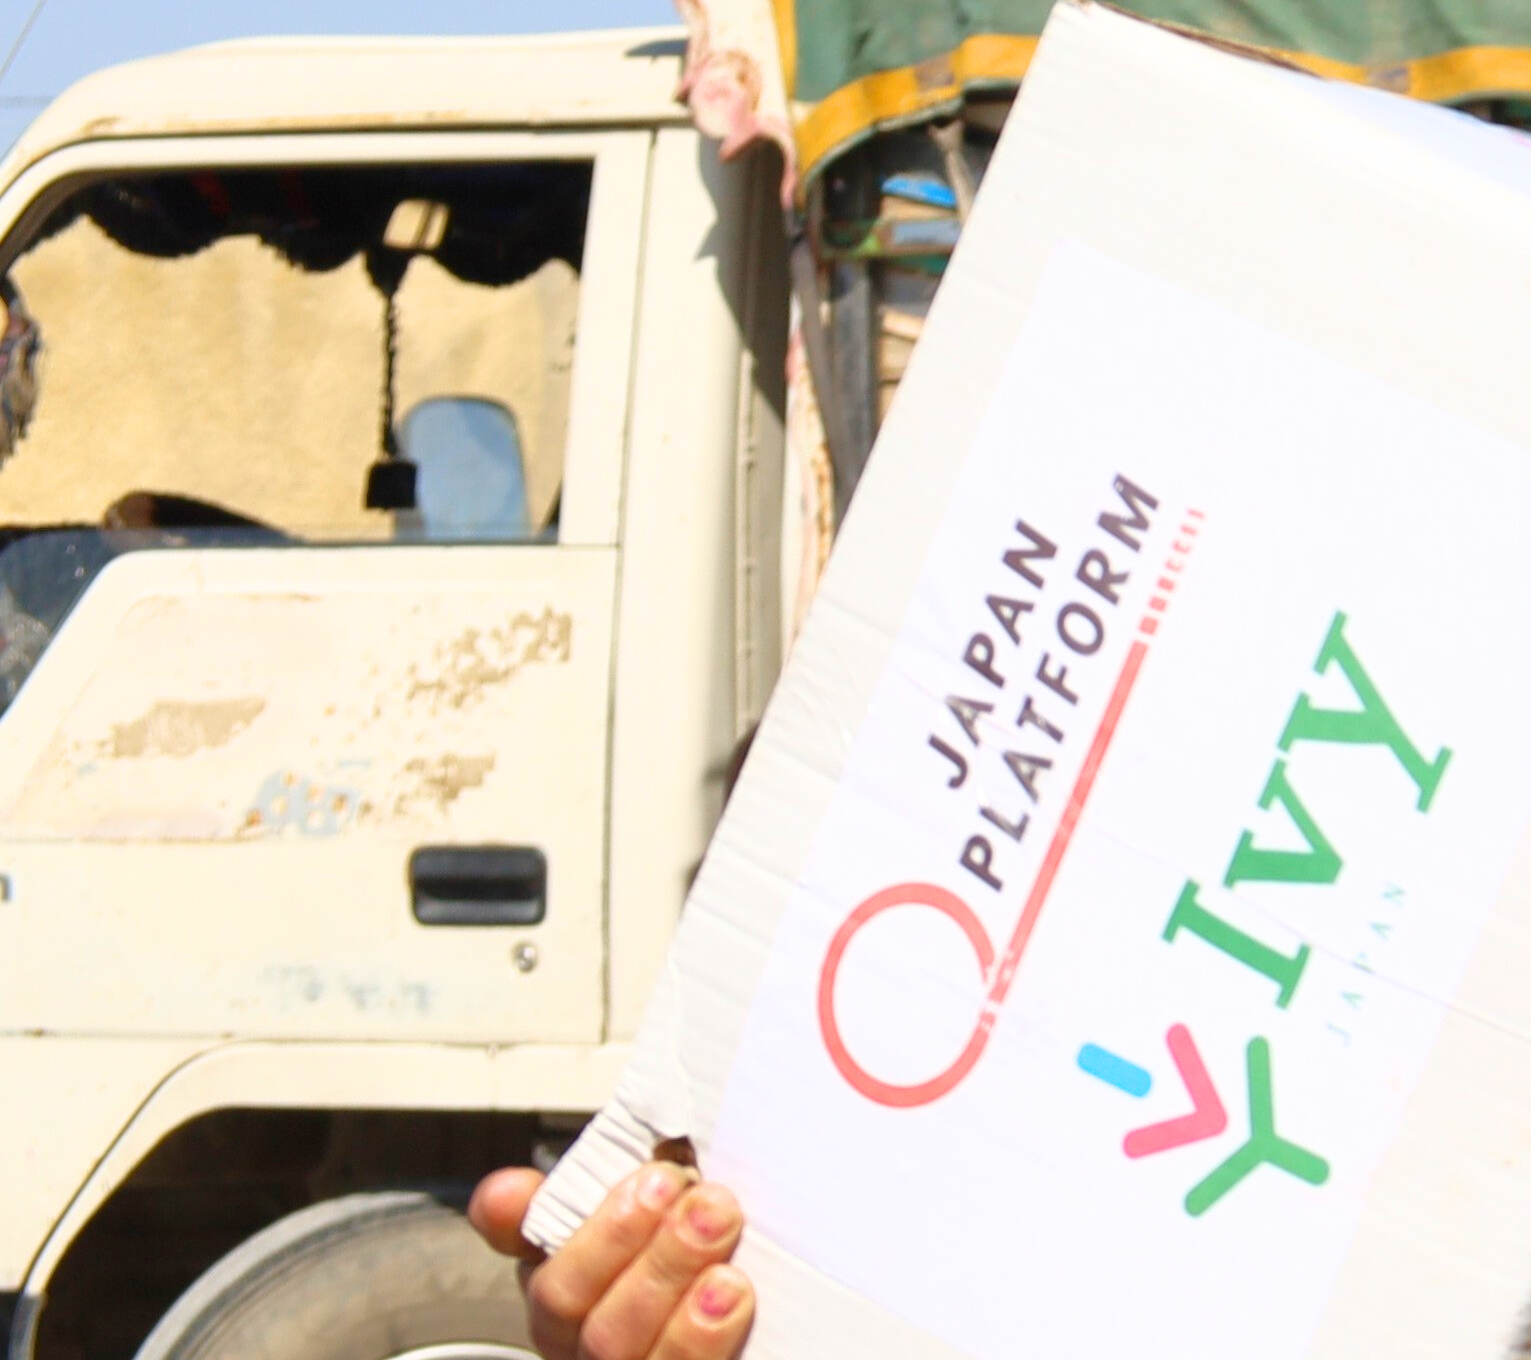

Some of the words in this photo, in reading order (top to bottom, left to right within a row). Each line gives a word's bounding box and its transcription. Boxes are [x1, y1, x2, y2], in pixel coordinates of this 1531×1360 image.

[927, 519, 1059, 790] JAPAN
[959, 473, 1160, 893] PLATFORM
[1161, 610, 1454, 1011] Ivy
